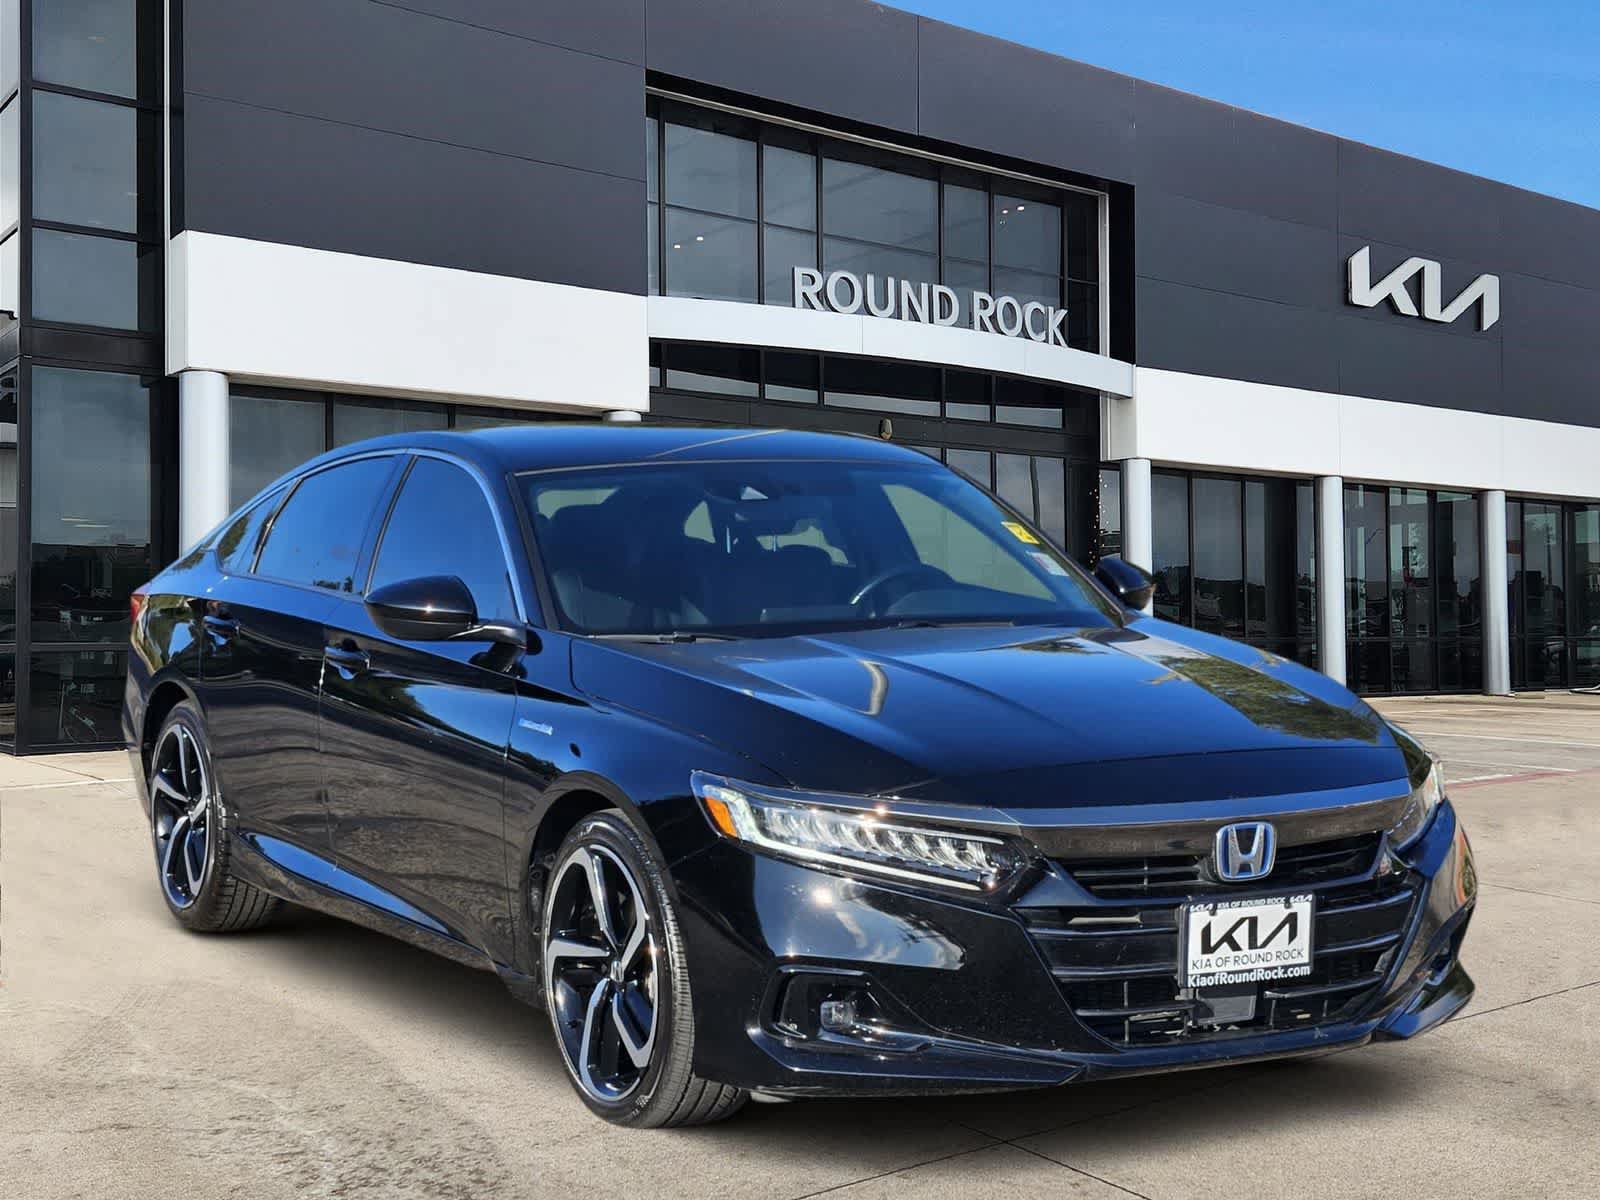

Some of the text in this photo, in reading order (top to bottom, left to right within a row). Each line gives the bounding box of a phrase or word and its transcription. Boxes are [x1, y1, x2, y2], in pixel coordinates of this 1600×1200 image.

[792, 266, 1069, 348] ROUND ROCK
[1347, 245, 1500, 331] KIA
[1200, 911, 1298, 955] KIA
[1187, 965, 1311, 988] KiaofRoundRock.com
[1191, 948, 1304, 970] KIA OF ROUND ROCK
